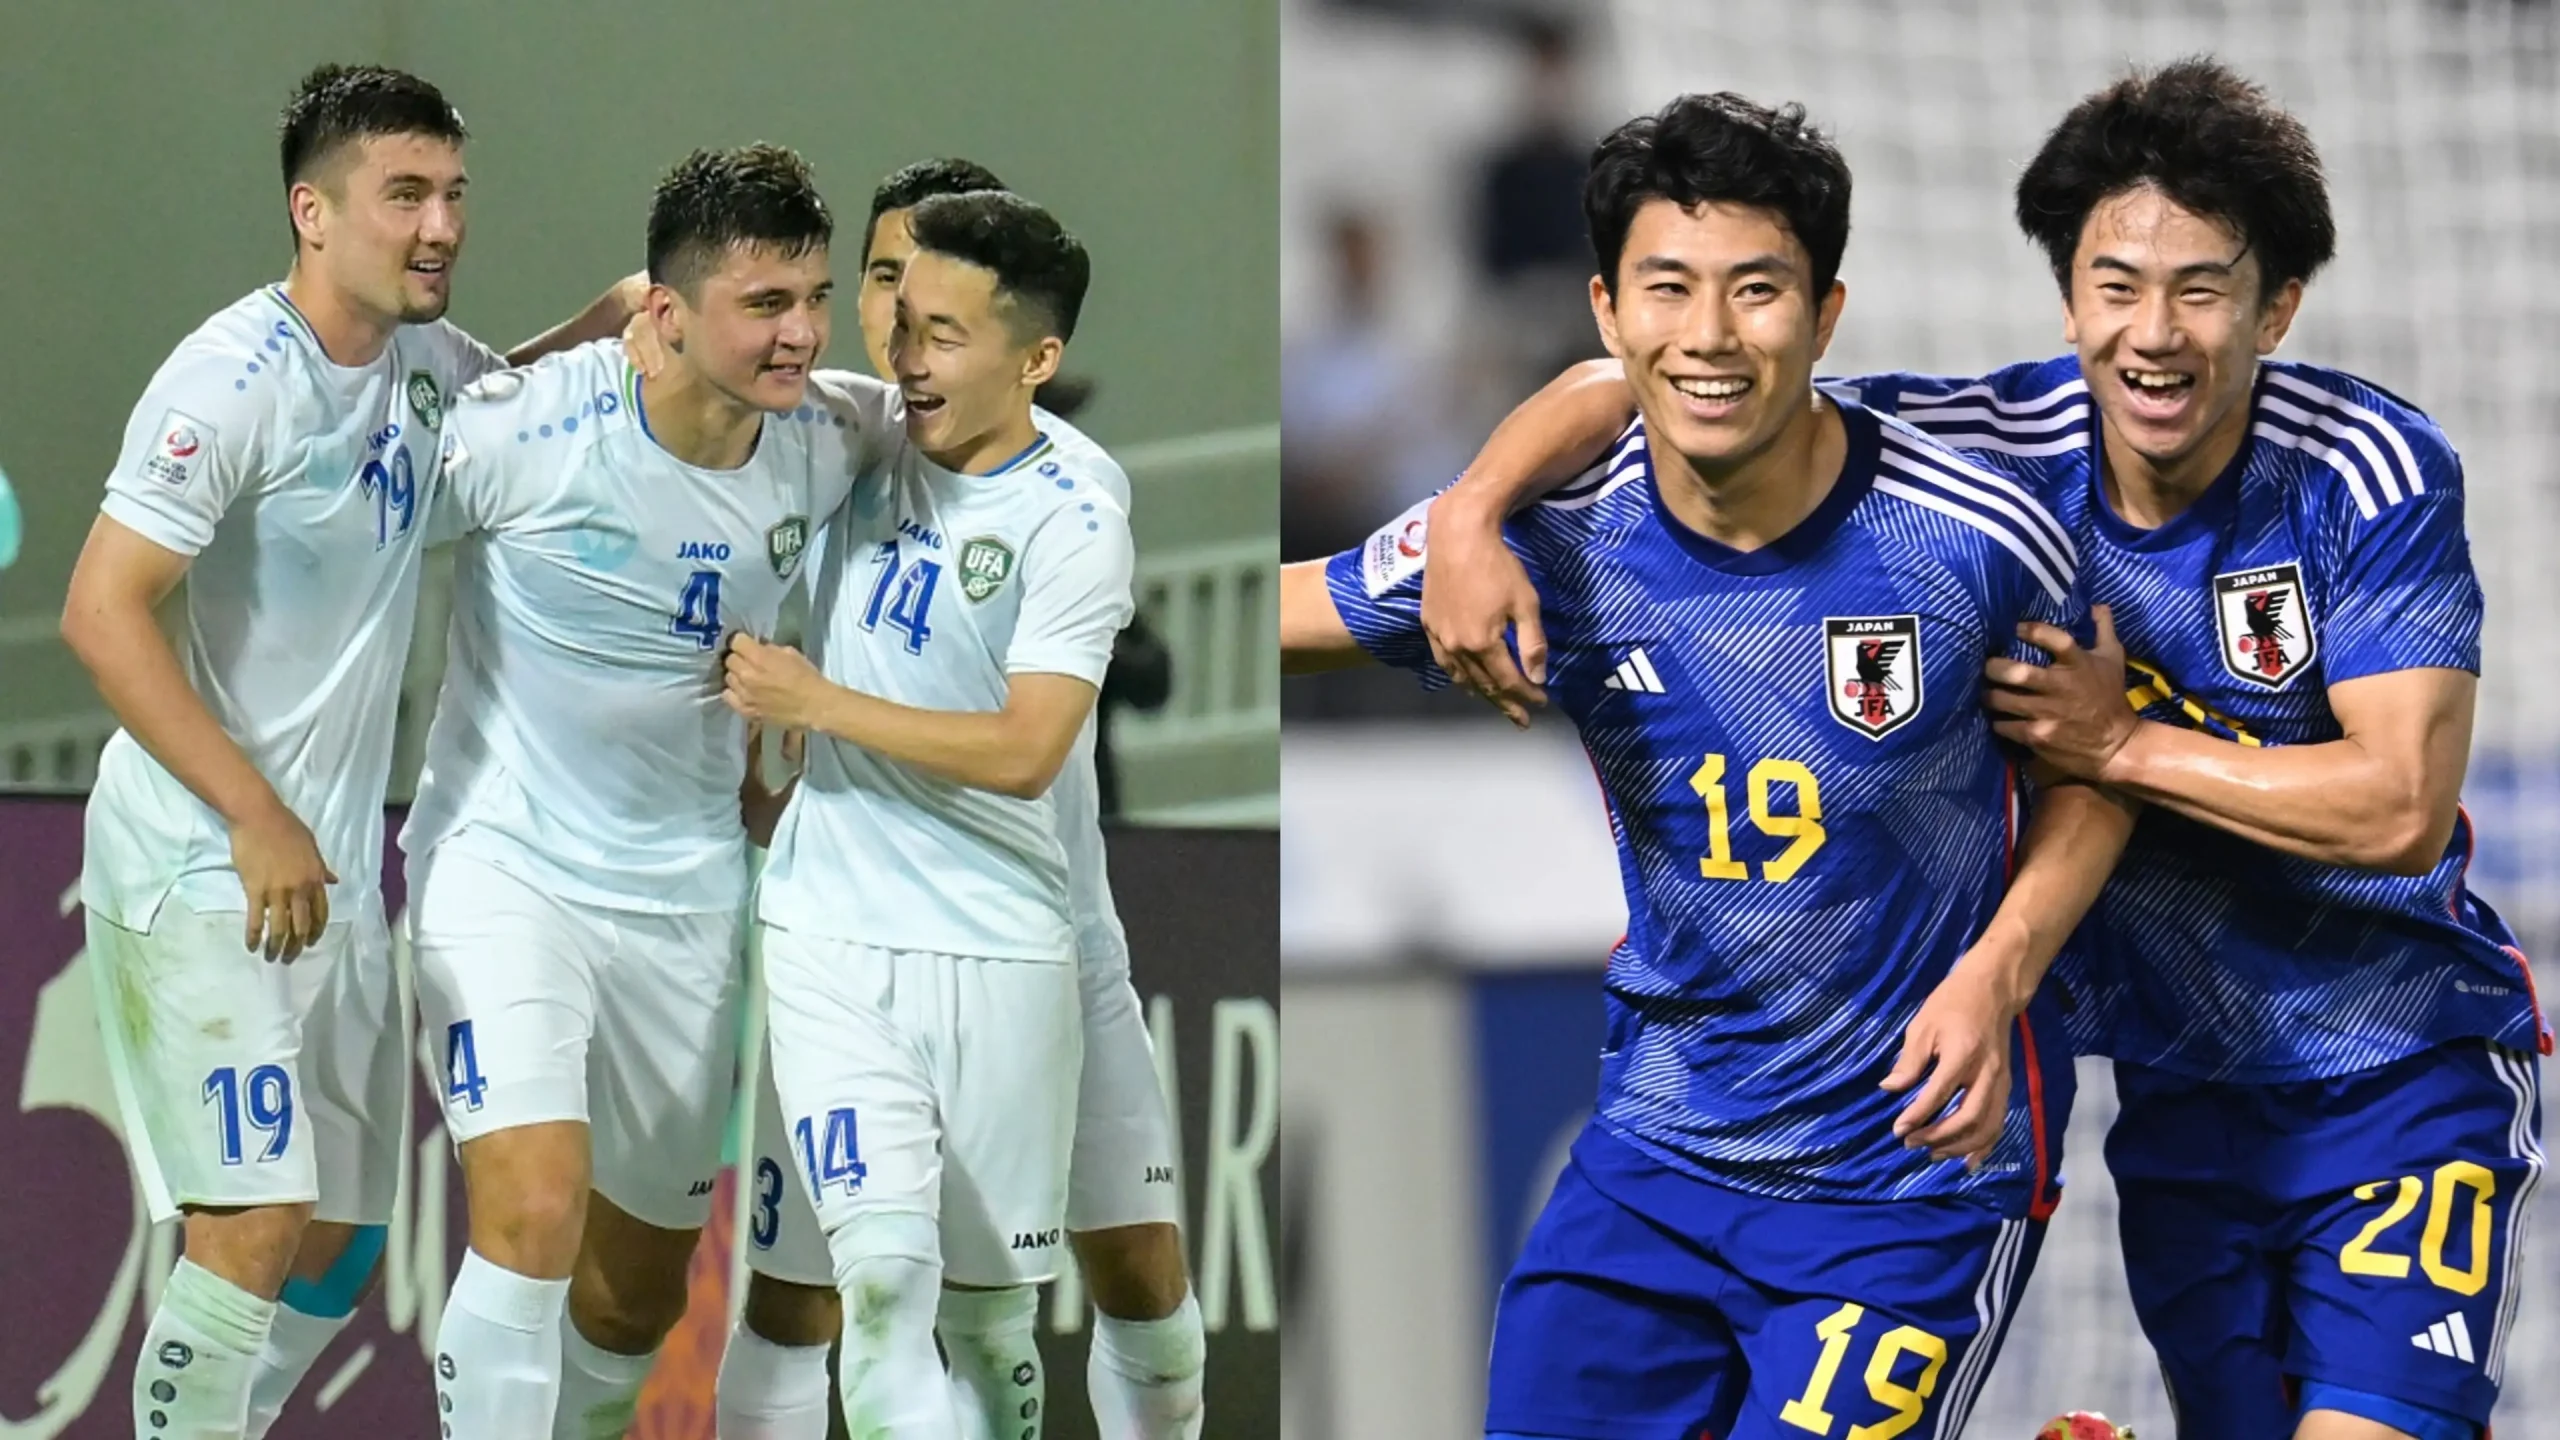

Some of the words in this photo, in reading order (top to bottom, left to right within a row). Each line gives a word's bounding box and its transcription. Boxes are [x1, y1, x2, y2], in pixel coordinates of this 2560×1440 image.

[361, 443, 415, 551] 19
[676, 541, 731, 561] JAKO
[773, 525, 803, 555] UFA
[965, 543, 1006, 578] UFA
[2232, 571, 2278, 588] JAPAN
[669, 571, 723, 651] 4
[857, 539, 942, 656] 14
[1845, 621, 1895, 633] JAPAN
[2251, 649, 2292, 672] JFA
[1854, 698, 1896, 718] JFA
[1688, 753, 1826, 884] 19
[447, 1019, 488, 1113] 4
[202, 1064, 293, 1166] 19
[795, 1107, 867, 1209] 14
[1011, 1228, 1060, 1250] JAKO
[2339, 1160, 2496, 1296] 20
[1779, 1302, 1948, 1440] 19
